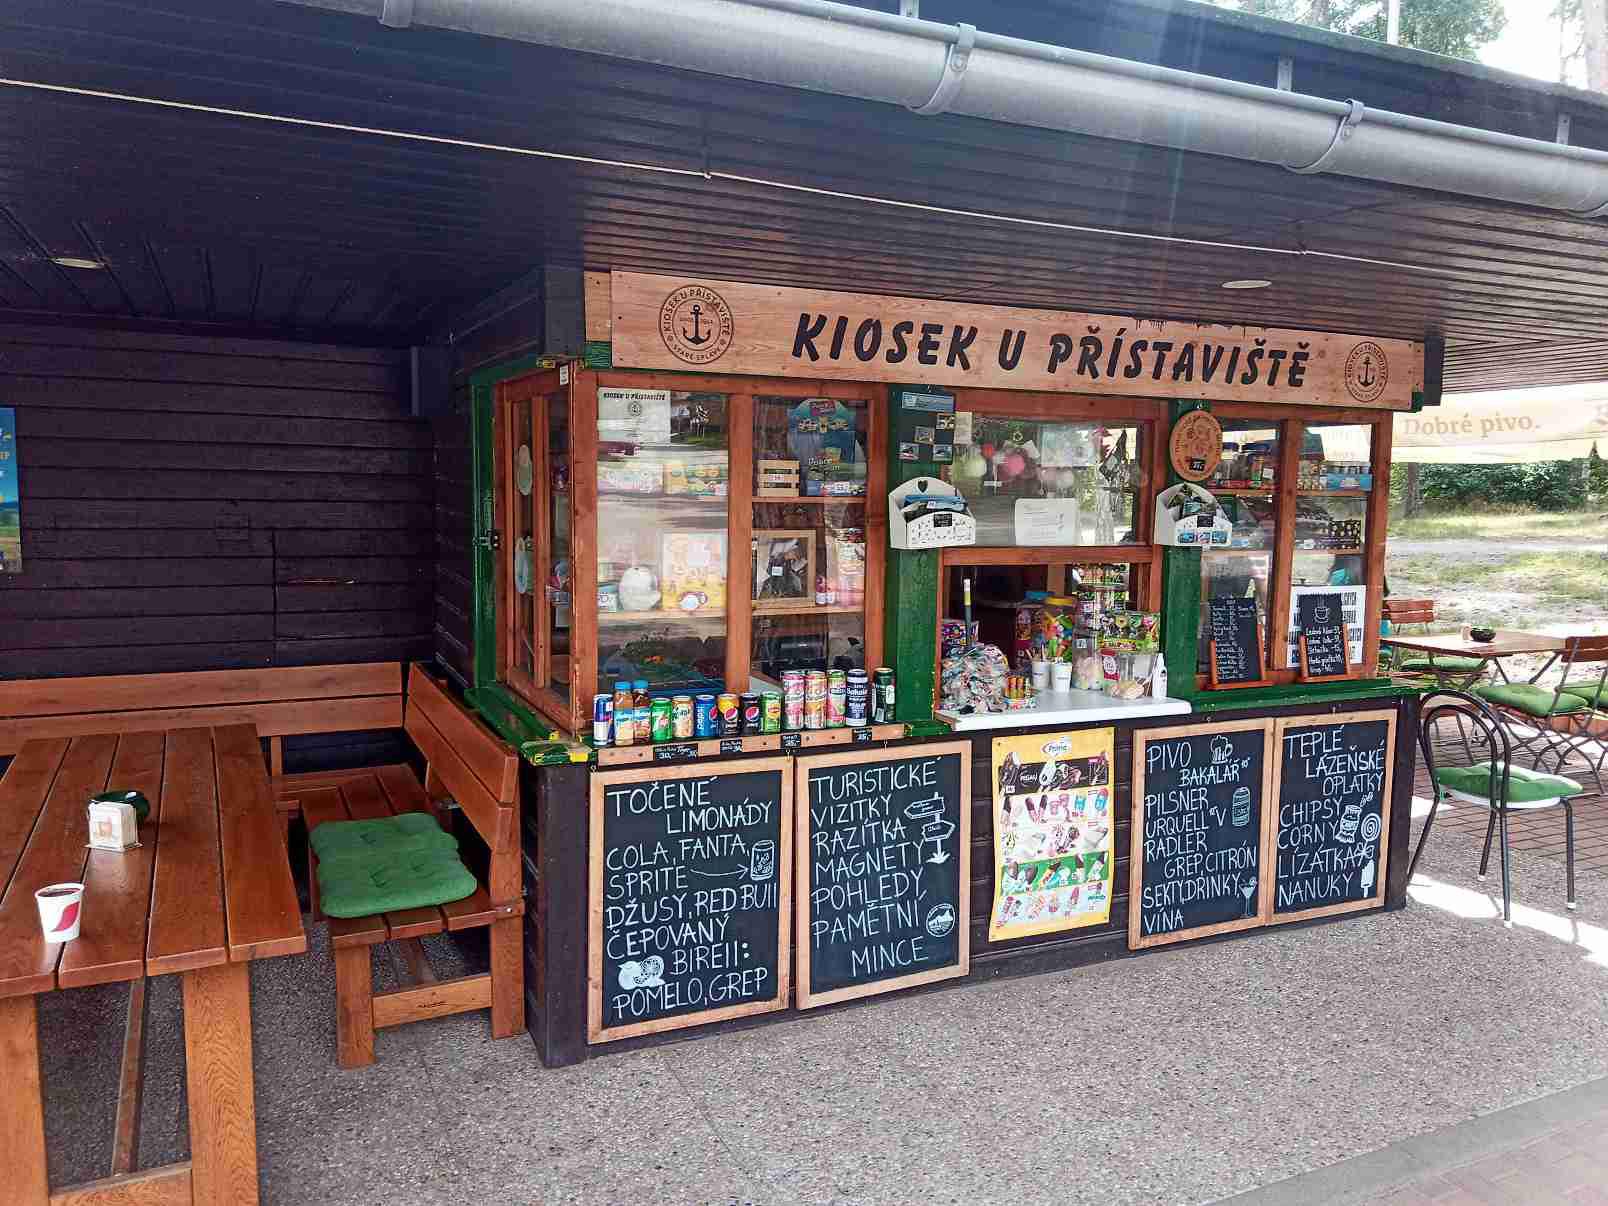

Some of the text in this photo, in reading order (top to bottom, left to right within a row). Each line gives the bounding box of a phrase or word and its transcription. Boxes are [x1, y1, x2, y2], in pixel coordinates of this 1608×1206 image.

[664, 296, 681, 332] KIOSEK
[680, 291, 687, 300] U
[791, 313, 978, 371] KIOSEK
[998, 328, 1027, 371] U
[1047, 325, 1311, 388] PŘÍSTAVIŠTĚ
[1405, 413, 1473, 436] Dobré
[1147, 741, 1192, 774] PIVO
[1283, 725, 1344, 759] TEPLÉ
[1305, 739, 1384, 778] LÁZEŇSKÉ
[809, 757, 942, 804] TURISTICKÉ
[1178, 758, 1240, 787] BAKALÁŘ
[1322, 771, 1384, 796] OPLATKY
[607, 776, 718, 816] TOČENÉ
[811, 793, 892, 828] VIZITKY
[1145, 787, 1210, 819] PILSNER
[1279, 796, 1343, 828] CHIPSY
[666, 797, 772, 834] LIMONÁDY
[1145, 813, 1209, 839] URQUELL
[812, 817, 906, 857] RAZÍTKA
[1144, 831, 1207, 863] RADLER
[1277, 822, 1339, 850] CORNY
[607, 841, 676, 871] COLA,
[815, 838, 925, 885] MAGNETY
[1204, 840, 1257, 873] CITRÓN
[1278, 843, 1357, 879] LÍZÁTKA
[607, 866, 689, 900] SPRITE
[811, 866, 924, 915] POHLEDY
[1278, 872, 1354, 907] NANUKY
[694, 886, 737, 917] RED
[607, 911, 729, 961] ČEPOVANÝ
[811, 890, 927, 949] PAMĚTNÍ
[1143, 909, 1184, 934] VÍNA
[851, 935, 929, 977] MINCE
[708, 967, 768, 1001] GREP
